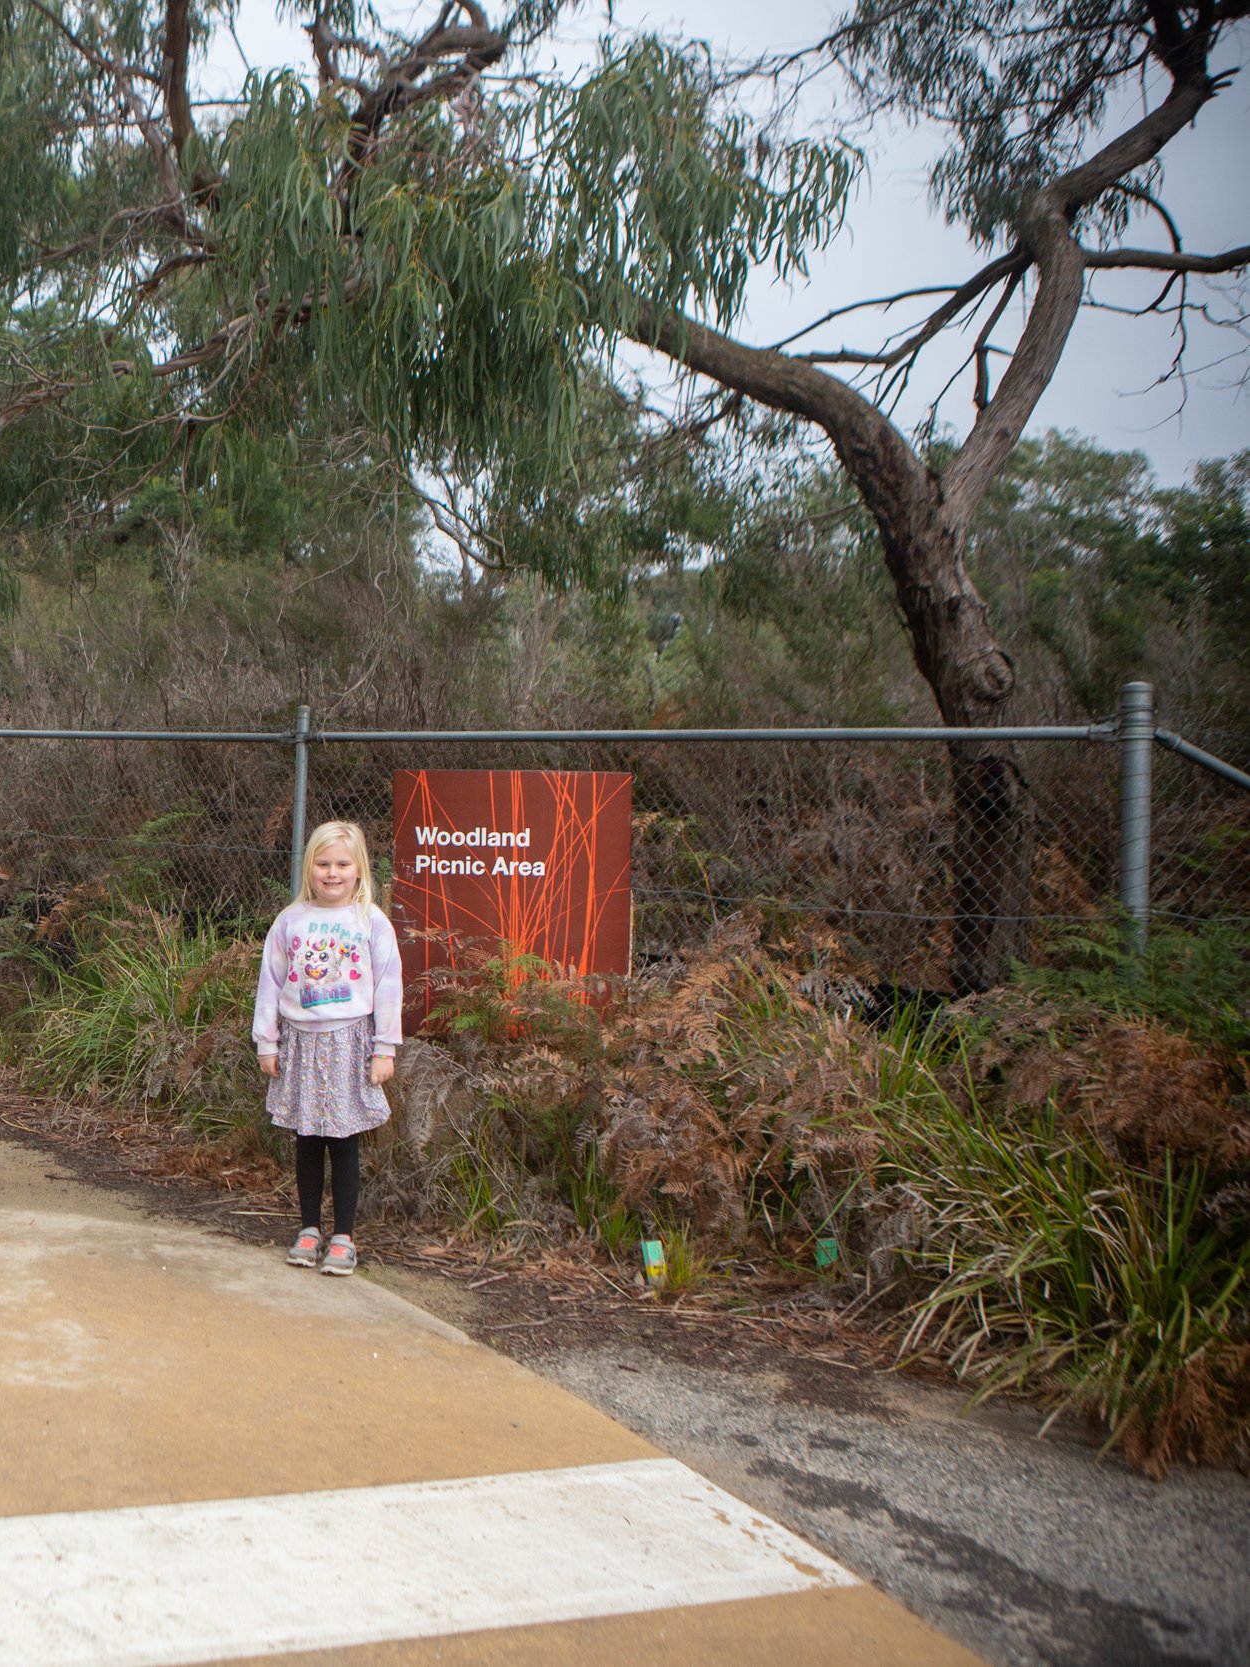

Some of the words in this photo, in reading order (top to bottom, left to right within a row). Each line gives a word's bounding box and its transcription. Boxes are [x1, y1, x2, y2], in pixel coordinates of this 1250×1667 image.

[415, 826, 531, 847] Woodland
[415, 855, 486, 875] Picnic
[491, 856, 546, 876] Area
[308, 922, 363, 943] DRAMA
